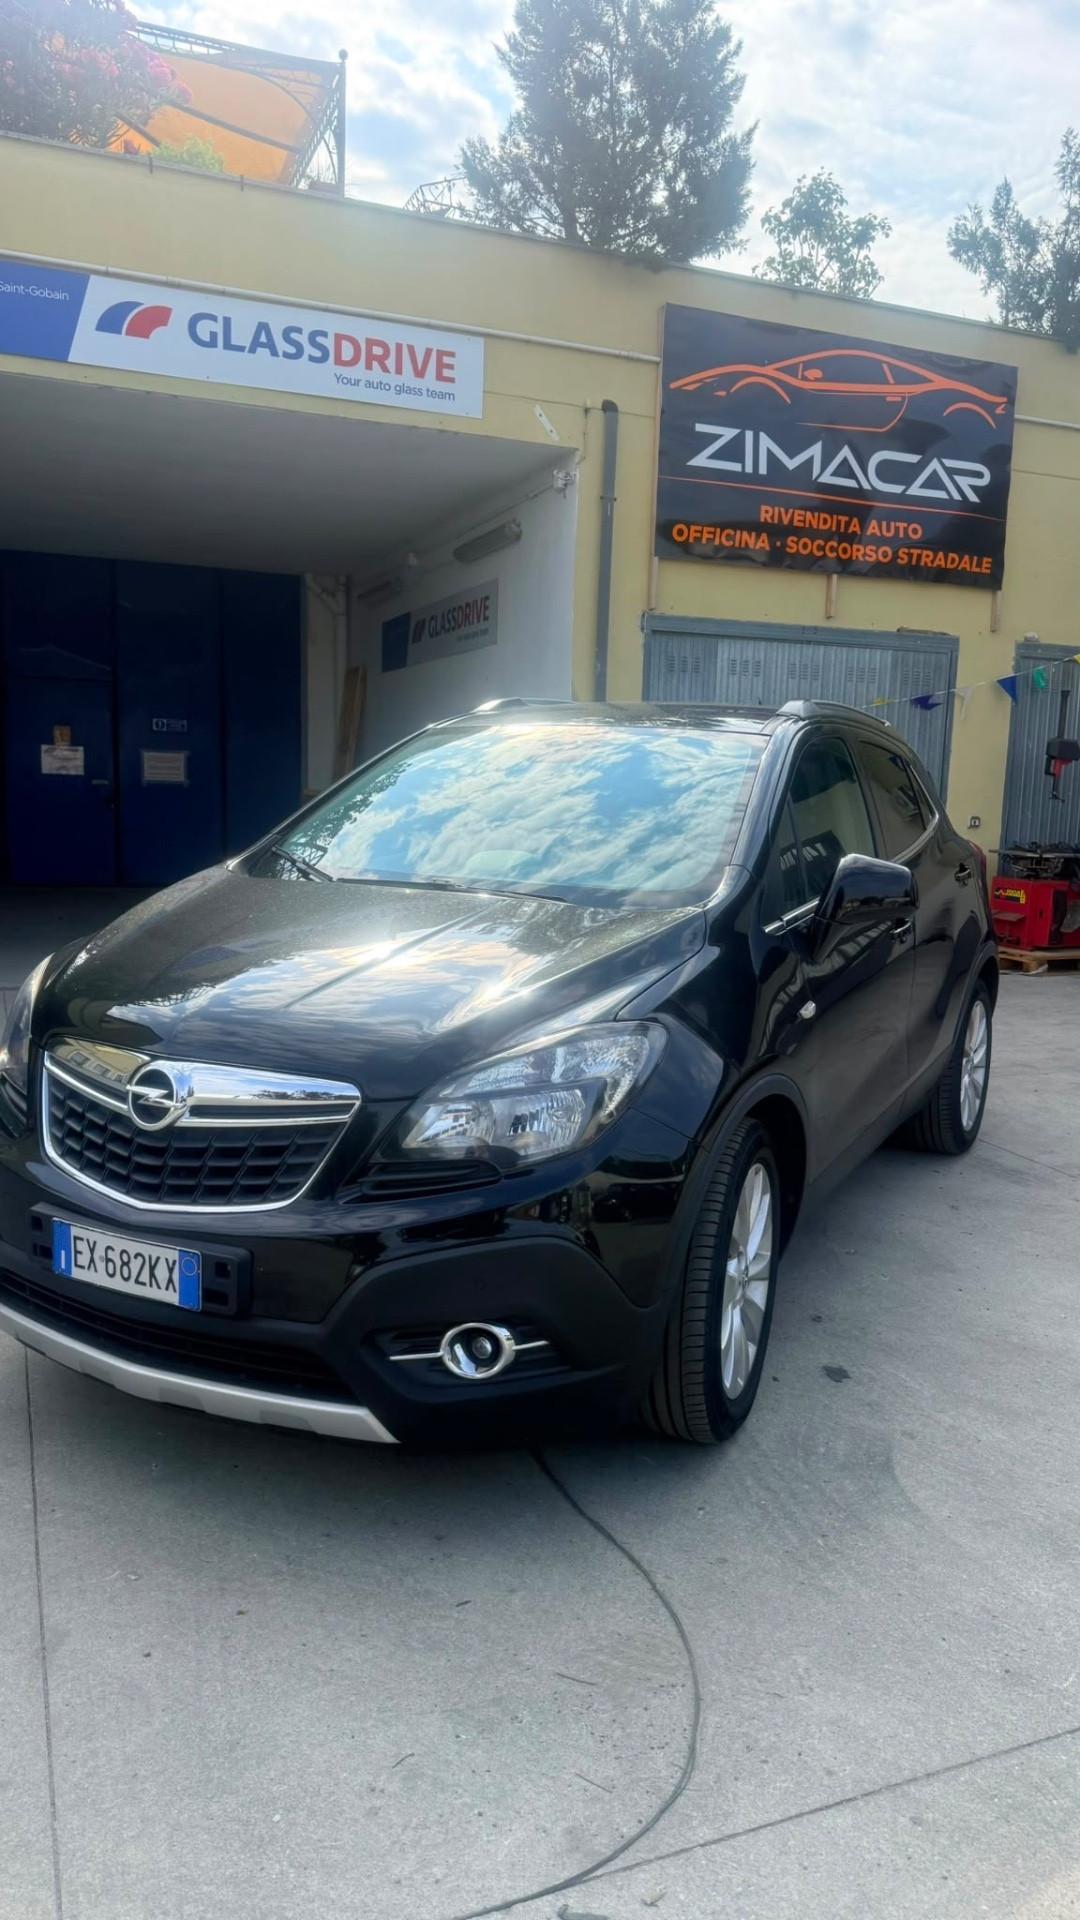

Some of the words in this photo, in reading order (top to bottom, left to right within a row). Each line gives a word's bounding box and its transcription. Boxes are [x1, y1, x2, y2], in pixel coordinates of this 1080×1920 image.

[188, 312, 456, 383] GLASSDRIVE
[334, 372, 362, 387] Your
[364, 379, 391, 392] auto
[394, 382, 423, 397] glass
[426, 387, 456, 402] team
[686, 423, 991, 503] ZIMACAR
[760, 504, 861, 535] RIVENDITA
[866, 519, 923, 540] AUTO
[672, 523, 770, 550] OFFICINA
[786, 535, 892, 563] SOCCORSO
[897, 547, 993, 574] STRADALE
[427, 596, 490, 638] GLASSDRIVE
